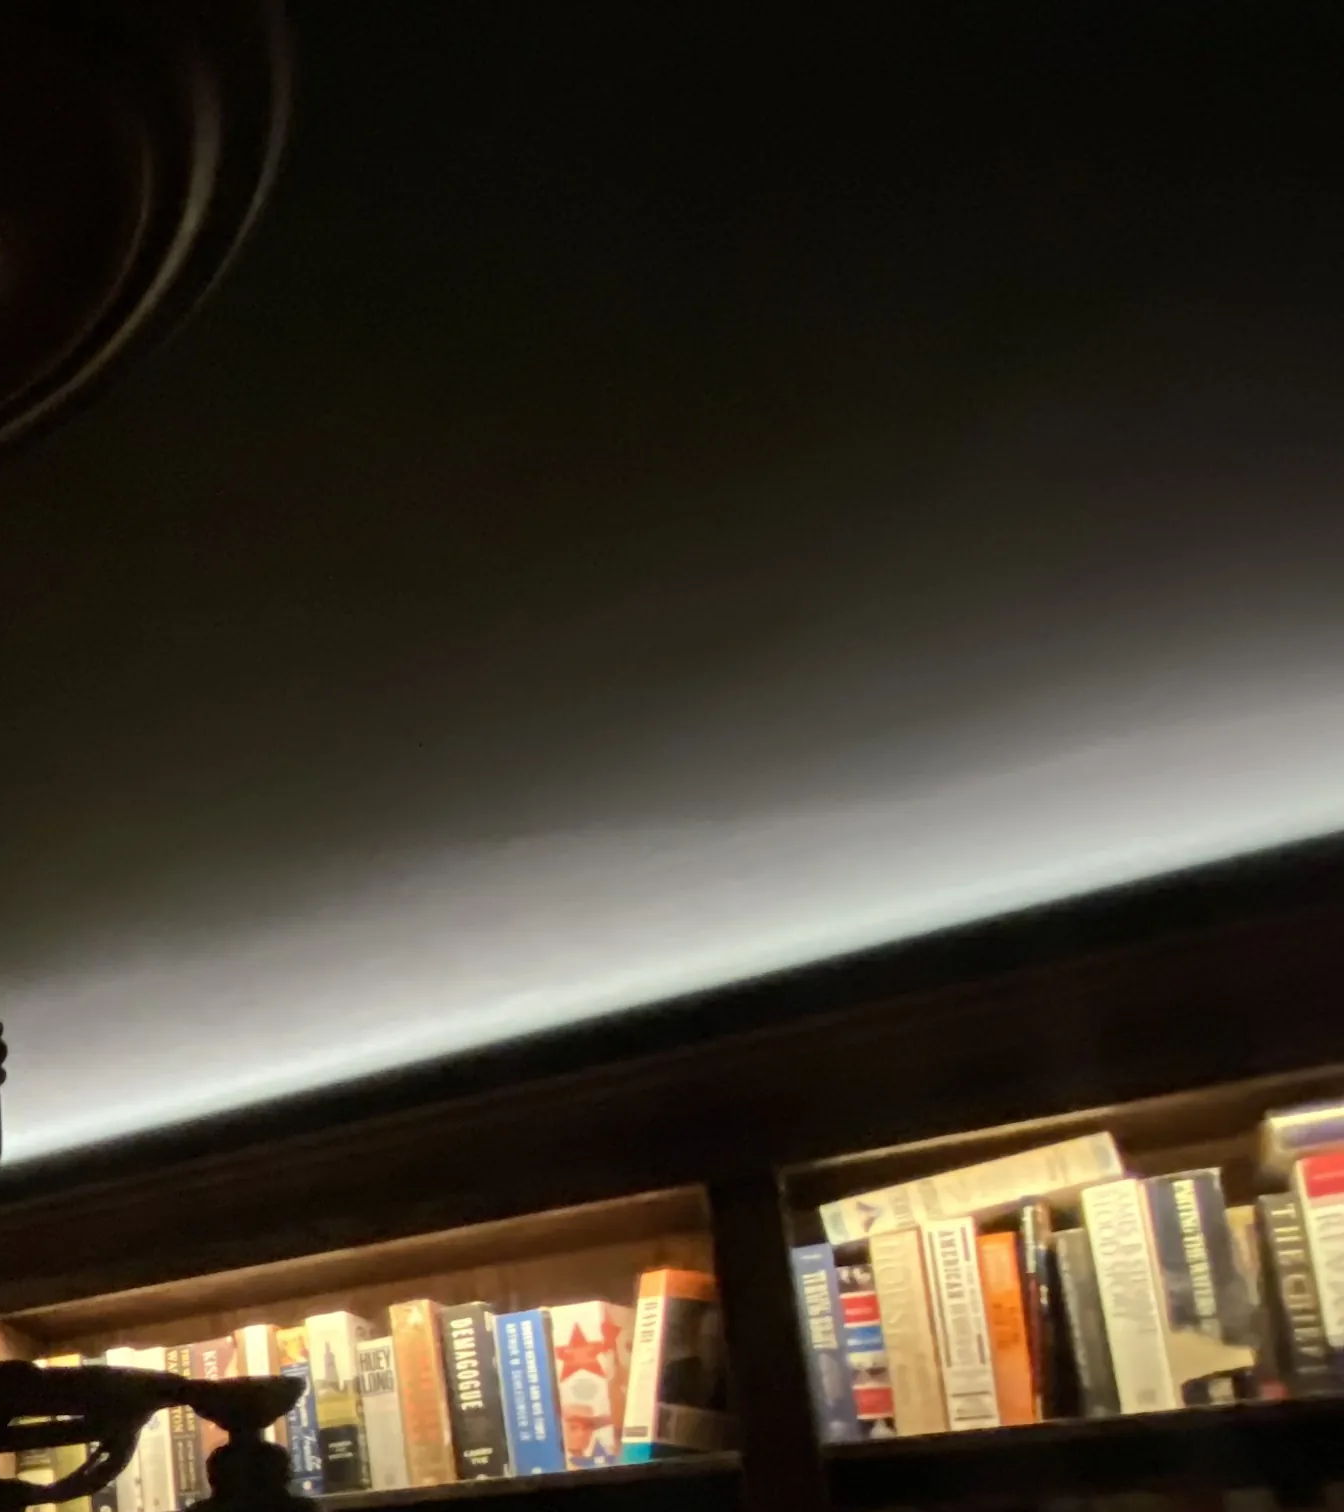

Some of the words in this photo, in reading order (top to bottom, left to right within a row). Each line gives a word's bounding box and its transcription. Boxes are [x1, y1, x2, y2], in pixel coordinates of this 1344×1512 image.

[938, 1229, 964, 1299] AMERICAN
[1269, 1202, 1305, 1266] THE
[446, 1316, 486, 1411] DEMAGOGUE
